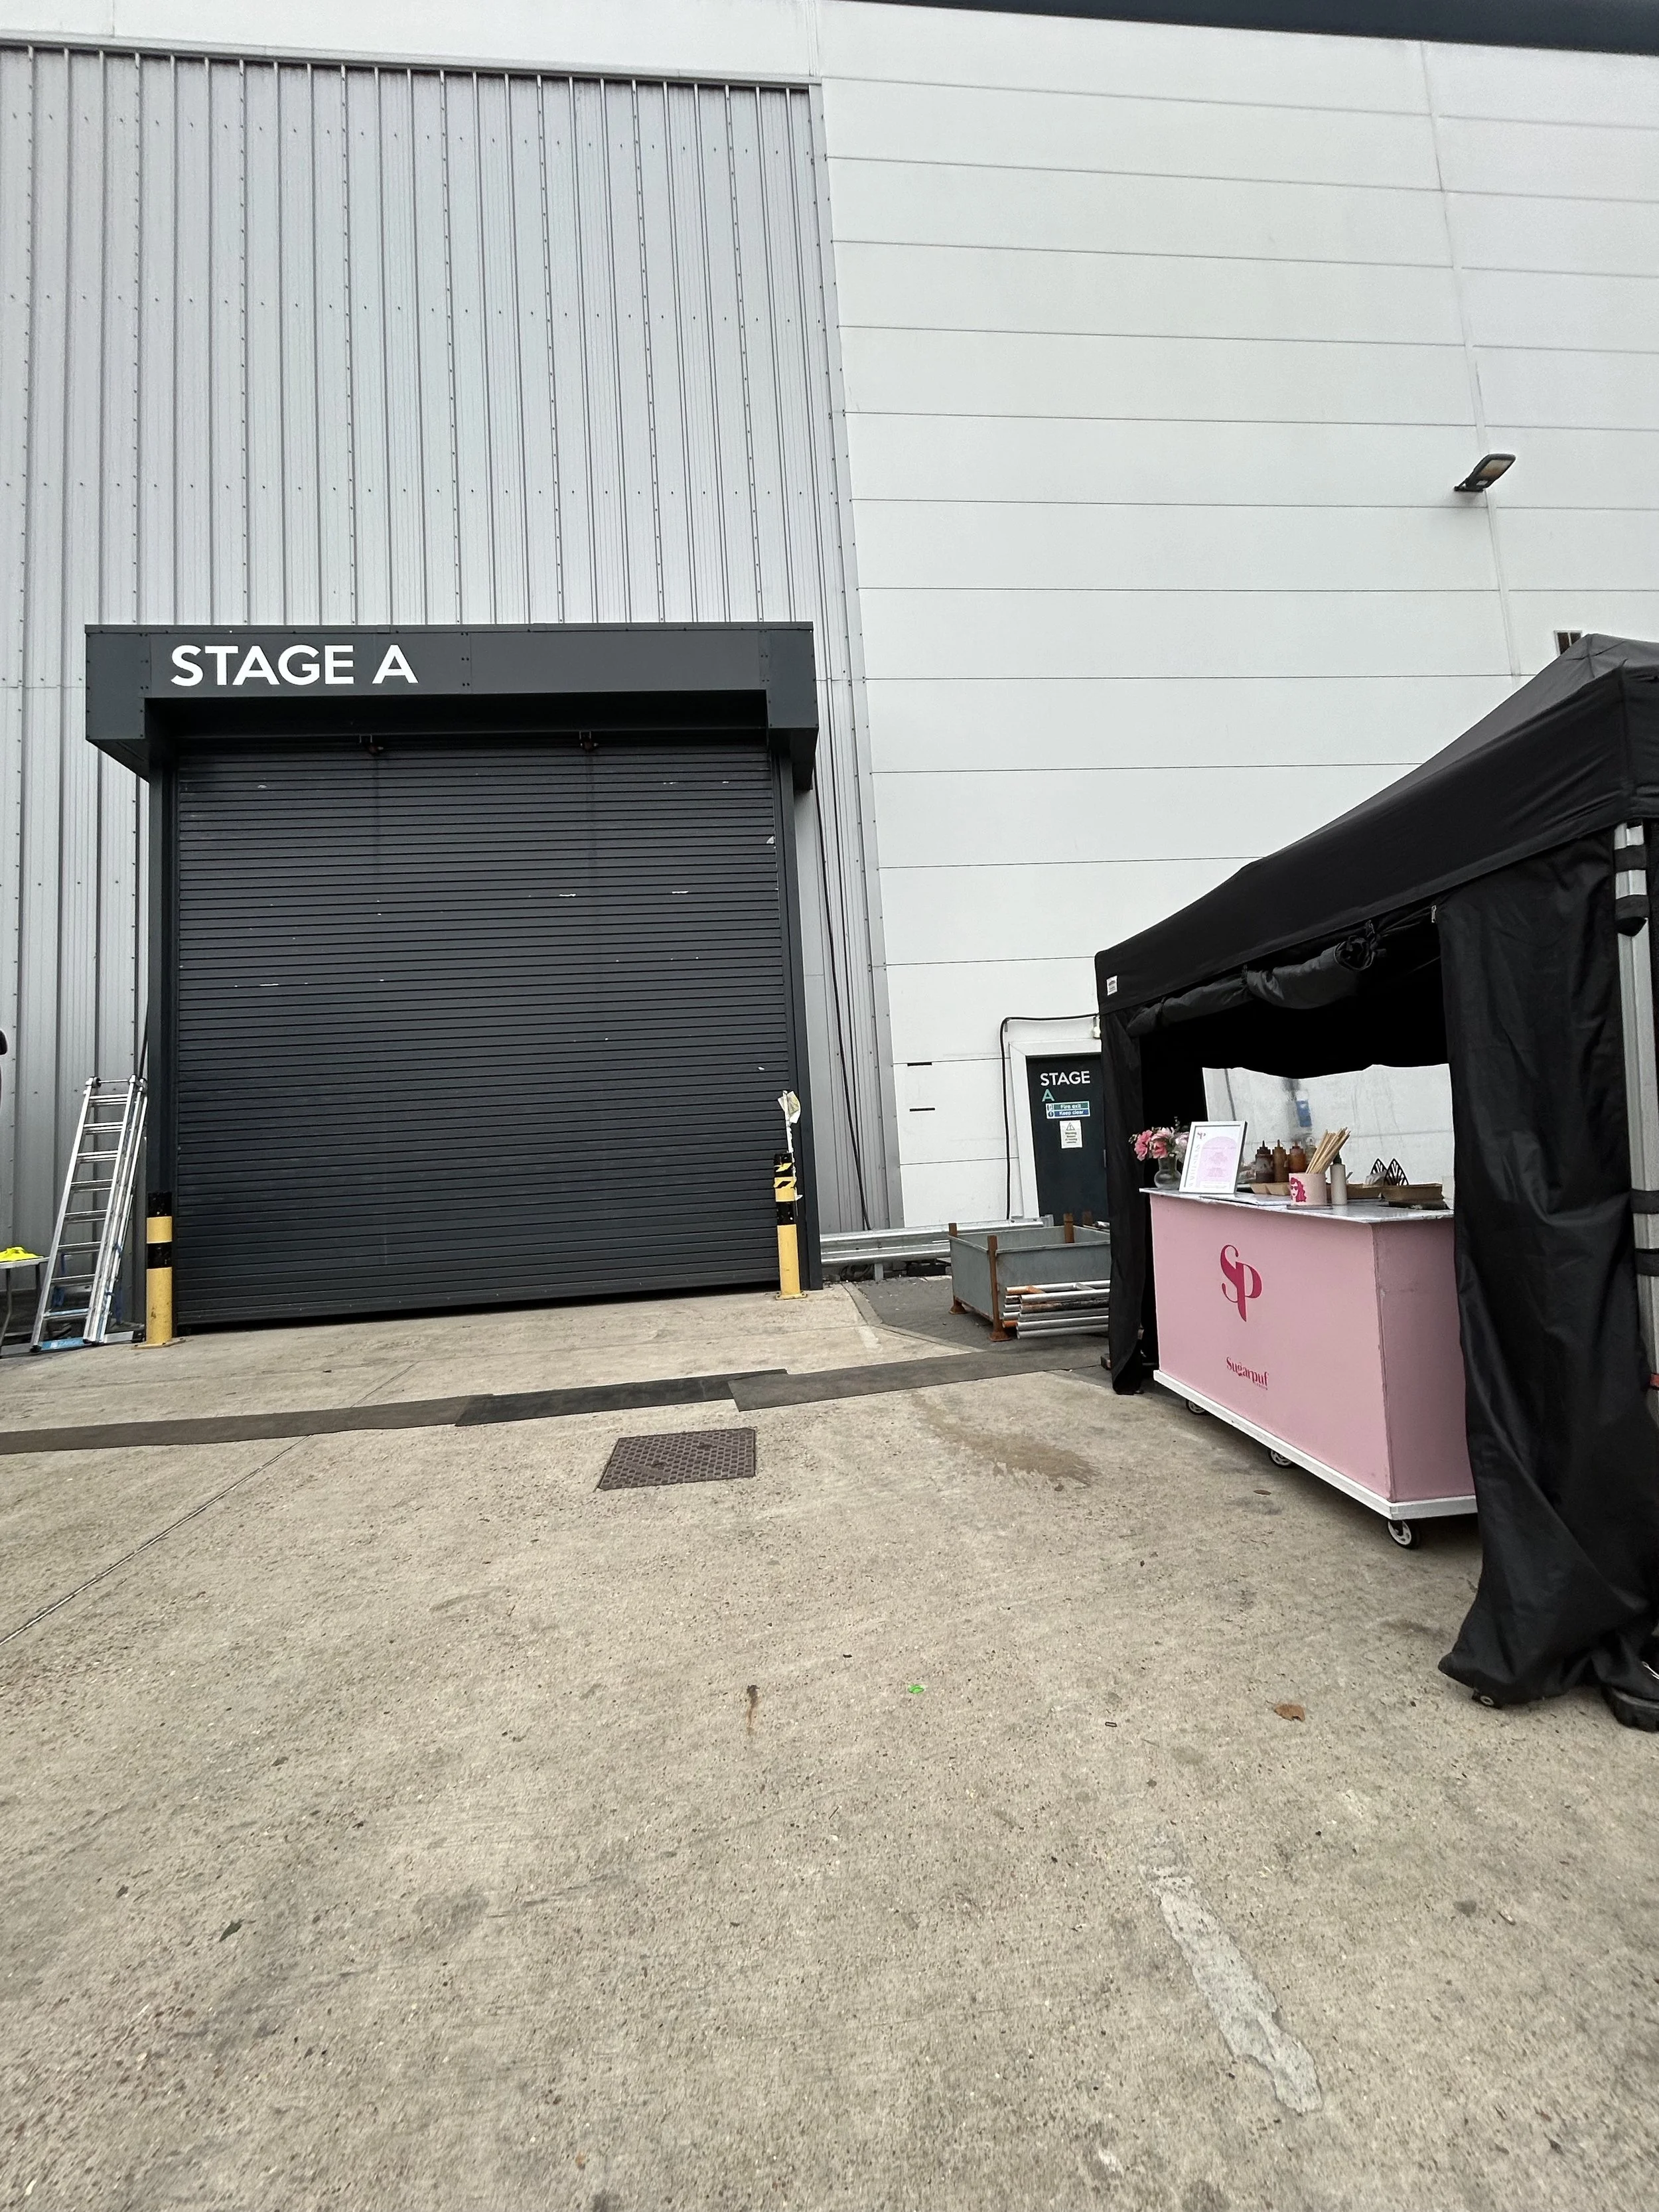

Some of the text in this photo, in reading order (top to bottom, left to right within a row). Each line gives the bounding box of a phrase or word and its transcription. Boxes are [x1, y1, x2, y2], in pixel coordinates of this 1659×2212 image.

[170, 644, 419, 687] STAGE A
[1040, 1070, 1090, 1086] STAGE
[1041, 1088, 1055, 1102] A
